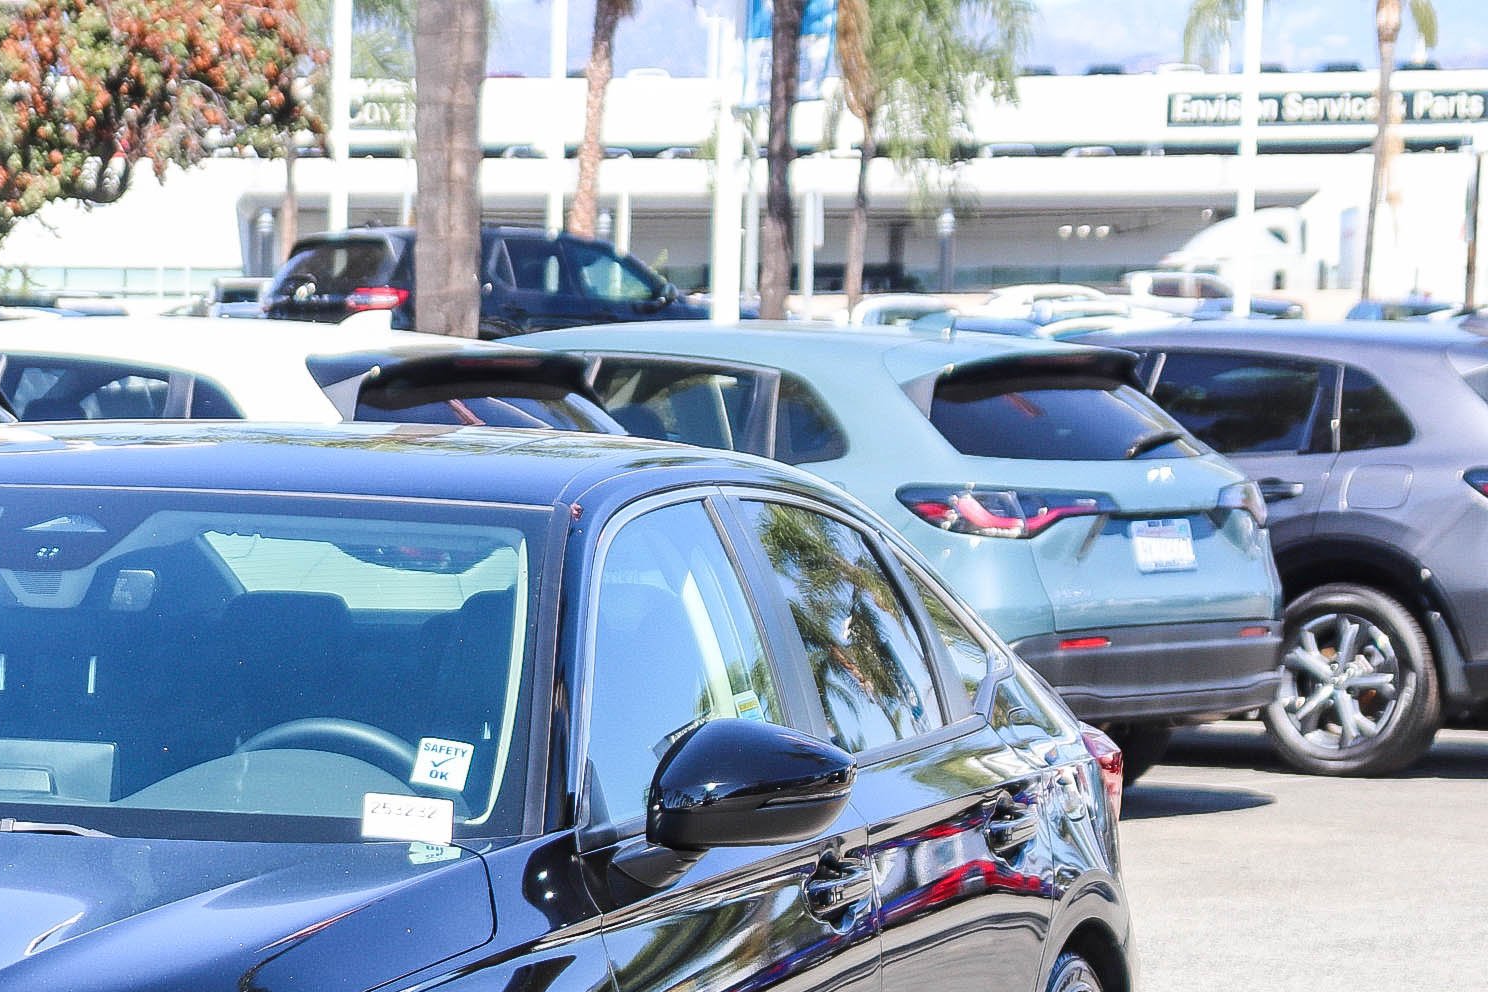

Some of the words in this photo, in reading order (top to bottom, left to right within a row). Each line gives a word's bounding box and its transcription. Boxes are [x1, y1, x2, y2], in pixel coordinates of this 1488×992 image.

[1413, 90, 1484, 119] Parts
[423, 742, 468, 758] SAFETY
[429, 769, 449, 781] OK
